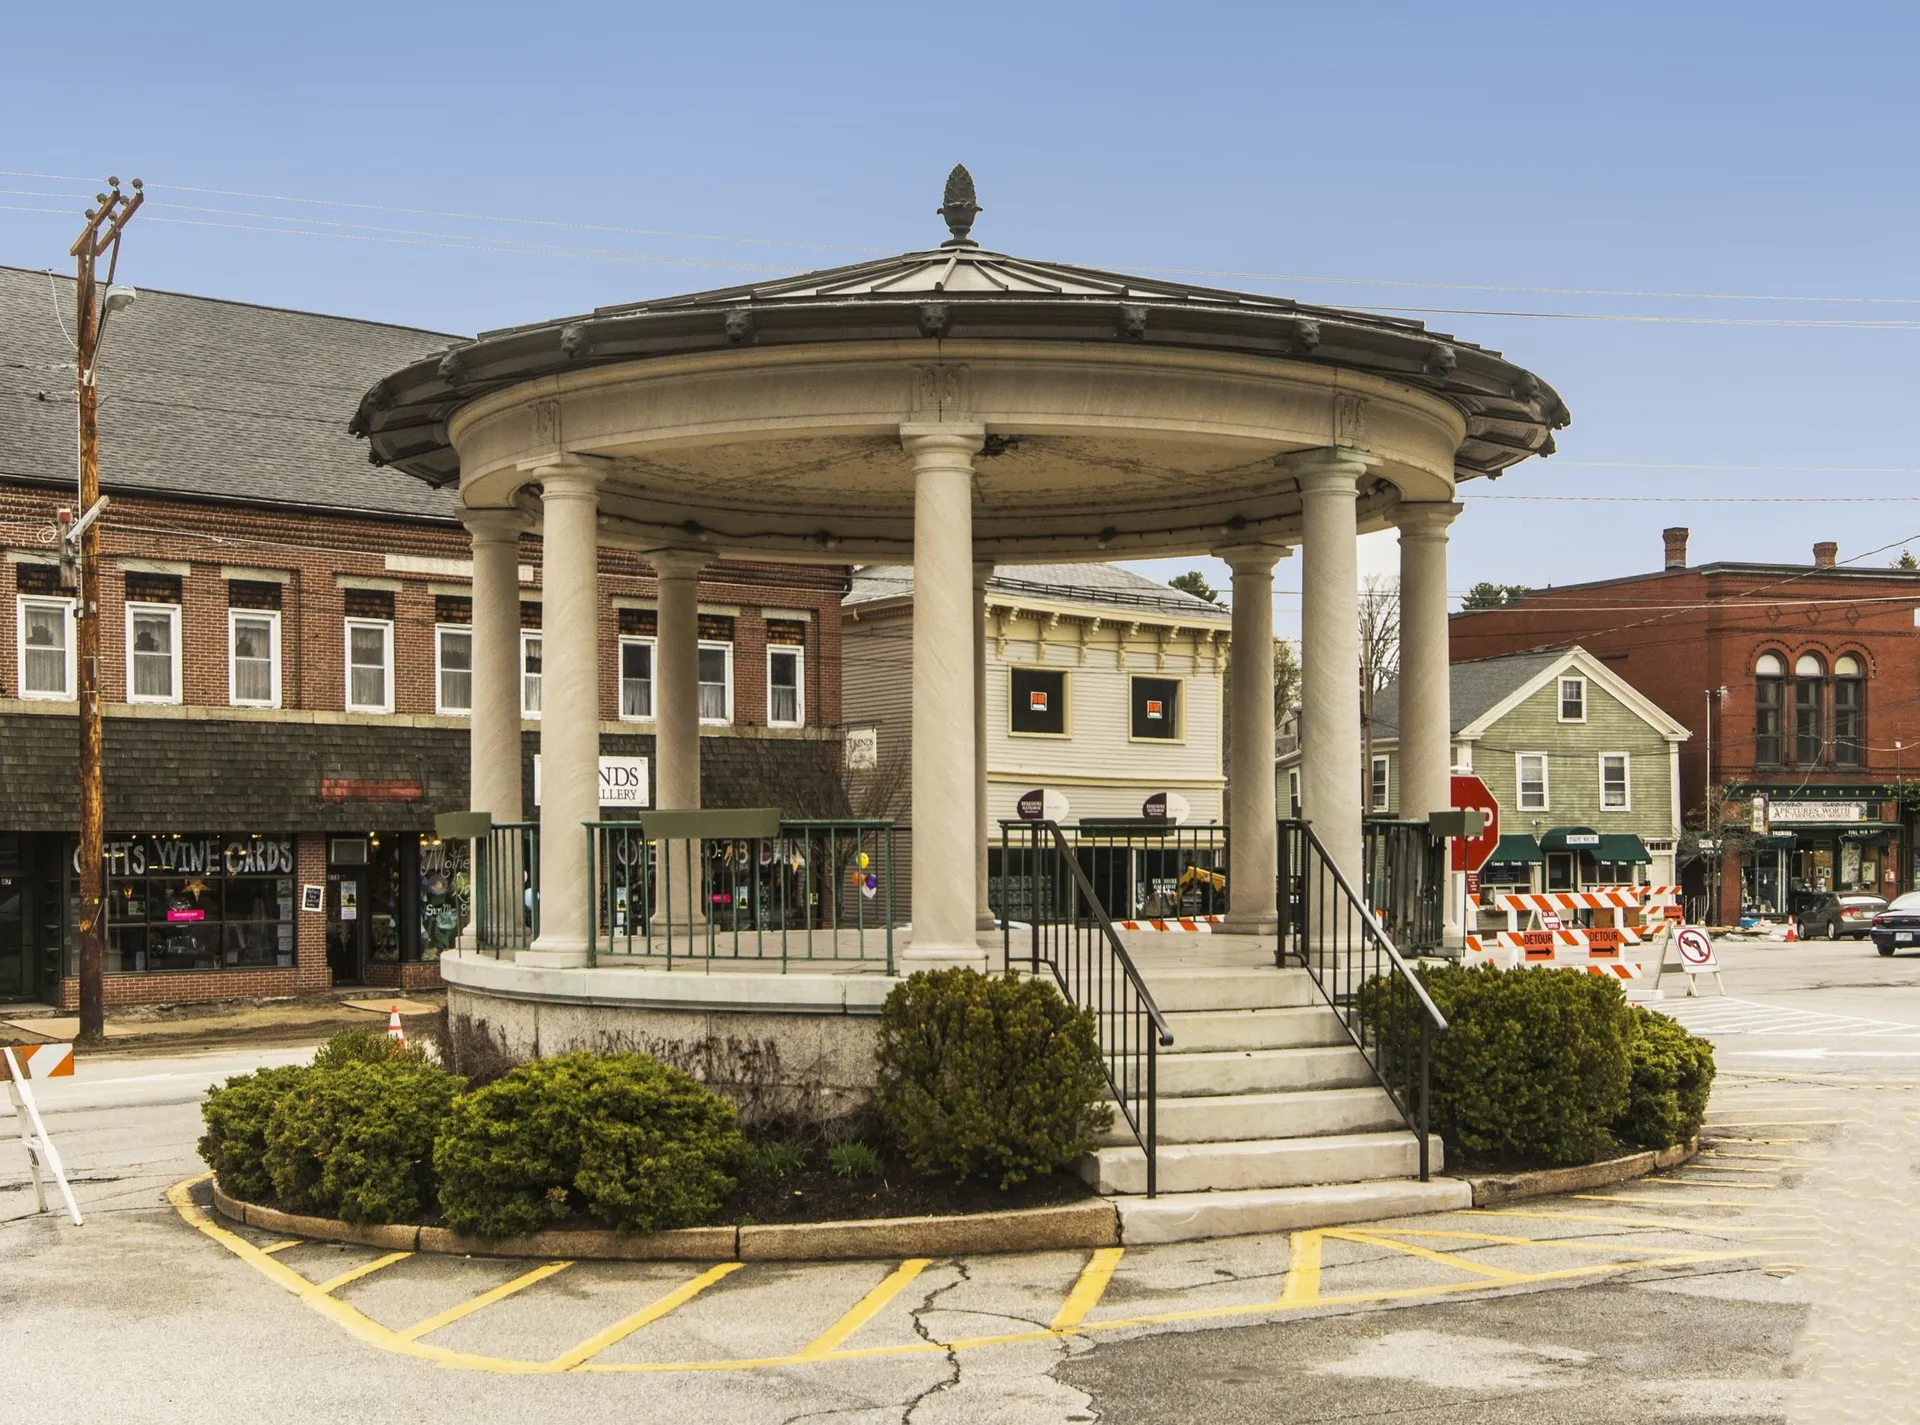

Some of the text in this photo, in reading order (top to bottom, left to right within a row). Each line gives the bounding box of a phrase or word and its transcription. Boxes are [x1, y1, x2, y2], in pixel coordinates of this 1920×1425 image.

[598, 766, 639, 787] NDS
[598, 788, 638, 801] LLERY
[1821, 807, 1851, 815] WORTH
[73, 839, 294, 875] FTS WINE CARDS
[420, 842, 471, 878] Mothe
[1524, 934, 1553, 945] DETOUR
[1590, 931, 1618, 942] DETOUR
